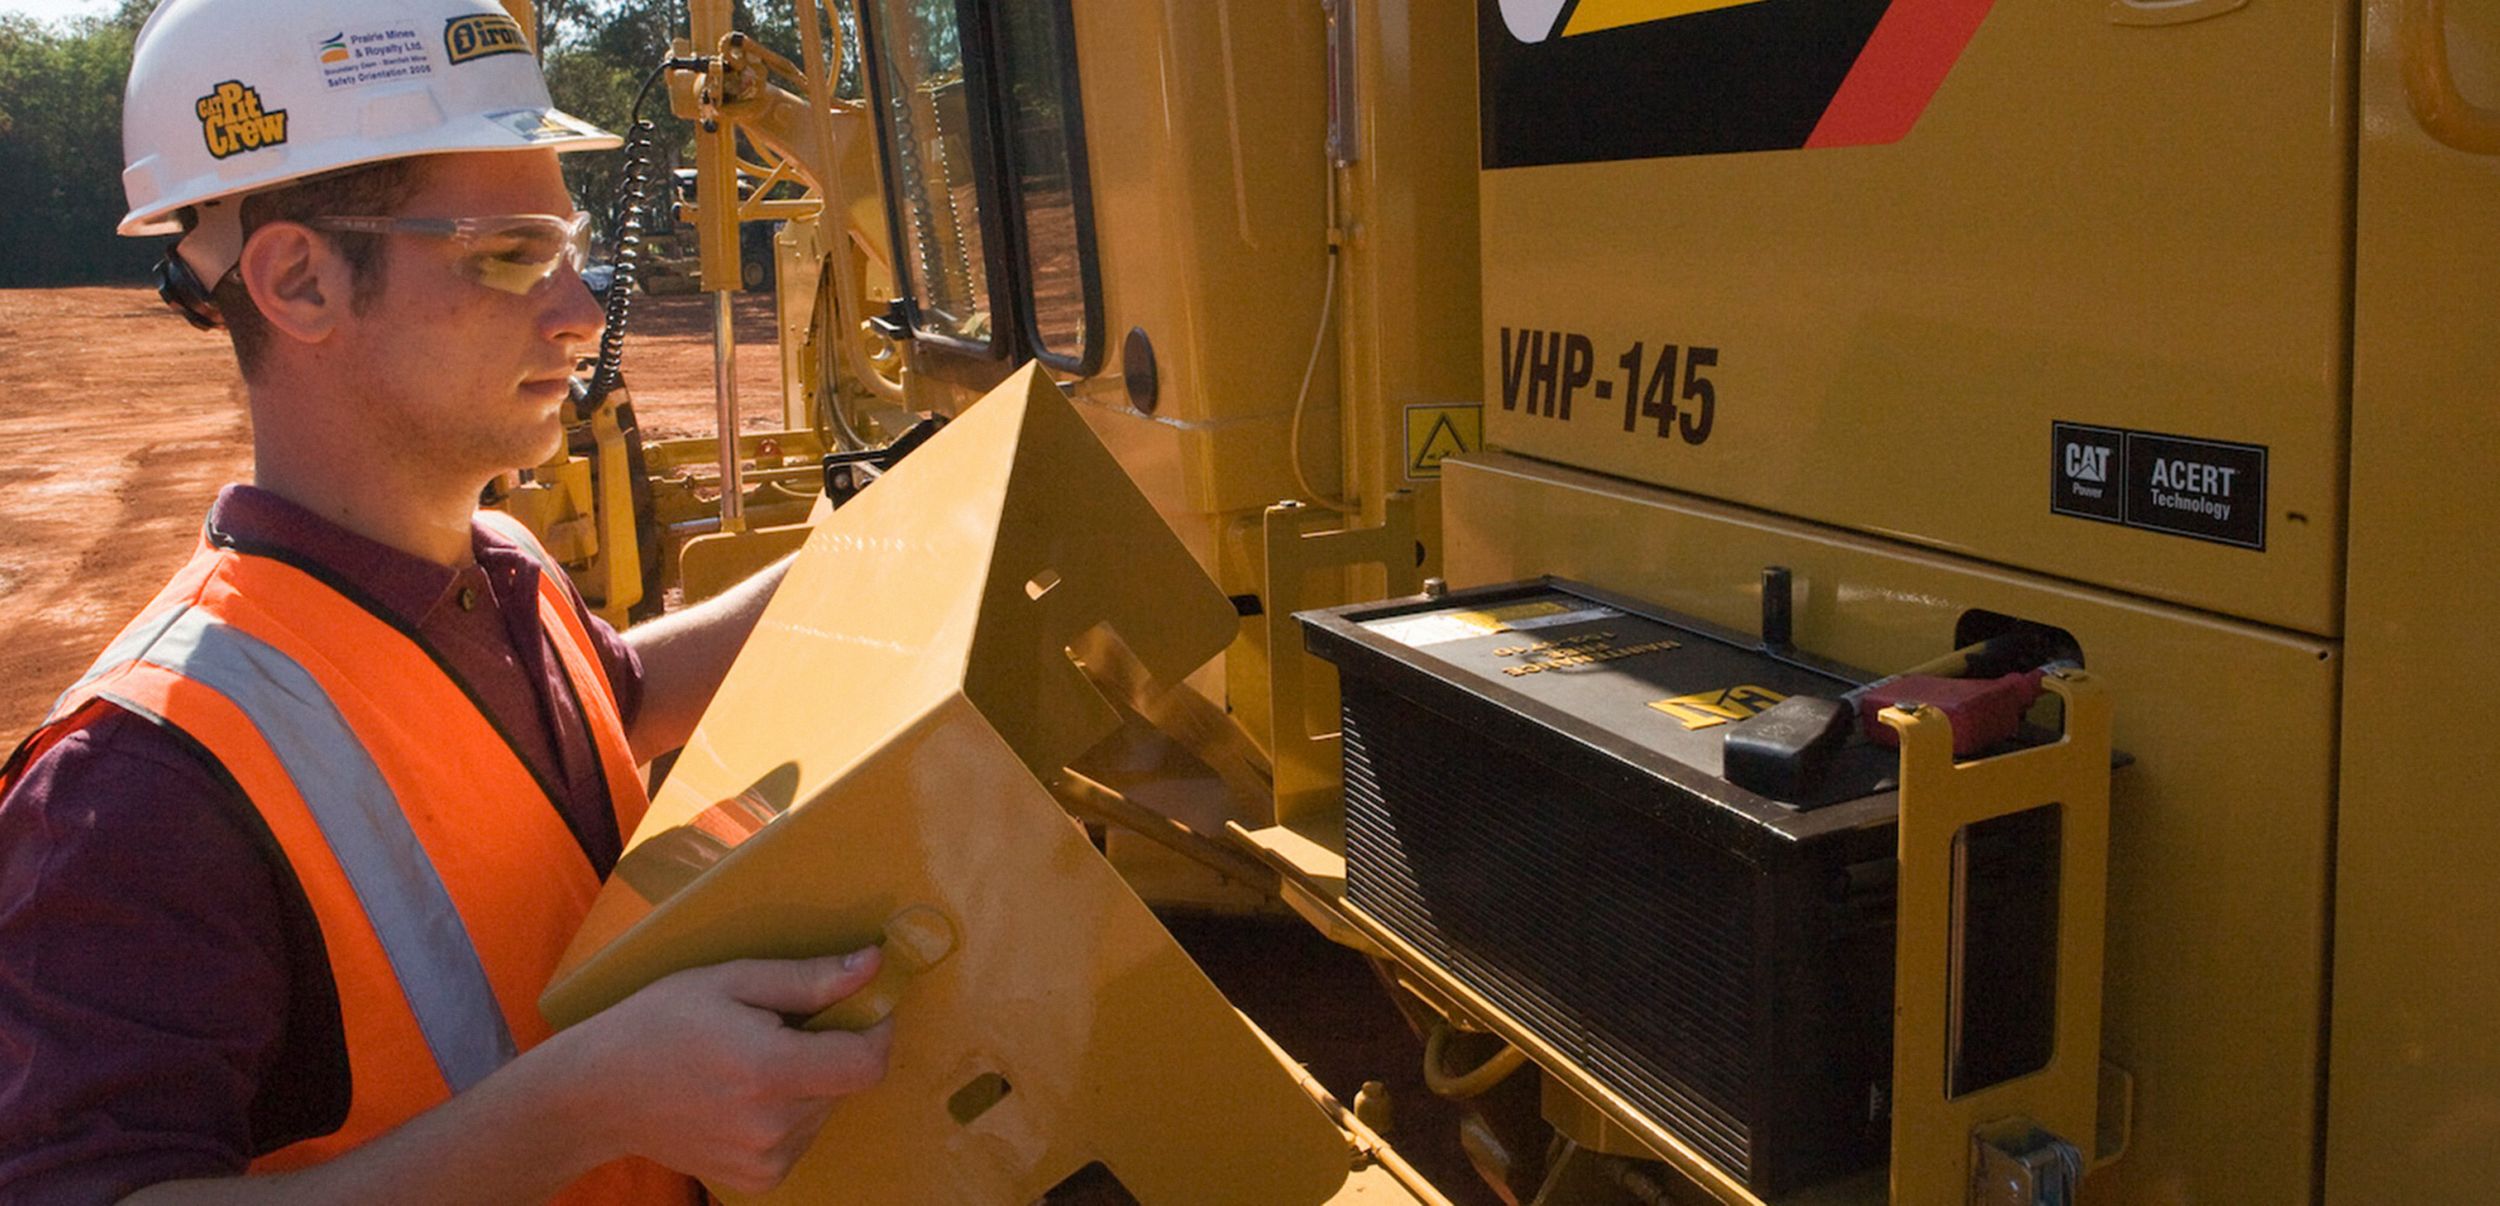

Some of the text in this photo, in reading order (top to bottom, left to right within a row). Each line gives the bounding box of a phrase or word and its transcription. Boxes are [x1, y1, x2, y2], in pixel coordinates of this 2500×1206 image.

[350, 30, 416, 45] Prairie Mines
[355, 49, 363, 58] &
[364, 43, 402, 56] Royalty
[328, 75, 357, 88] Safety
[357, 67, 408, 83] Orientation
[198, 82, 262, 125] CAT Pit
[206, 112, 285, 156] Crew
[1501, 327, 1719, 446] VHP-145
[2065, 442, 2111, 483] CAT
[2151, 457, 2236, 497] ACERT
[2072, 481, 2103, 499] Power
[2150, 487, 2232, 521] Technology
